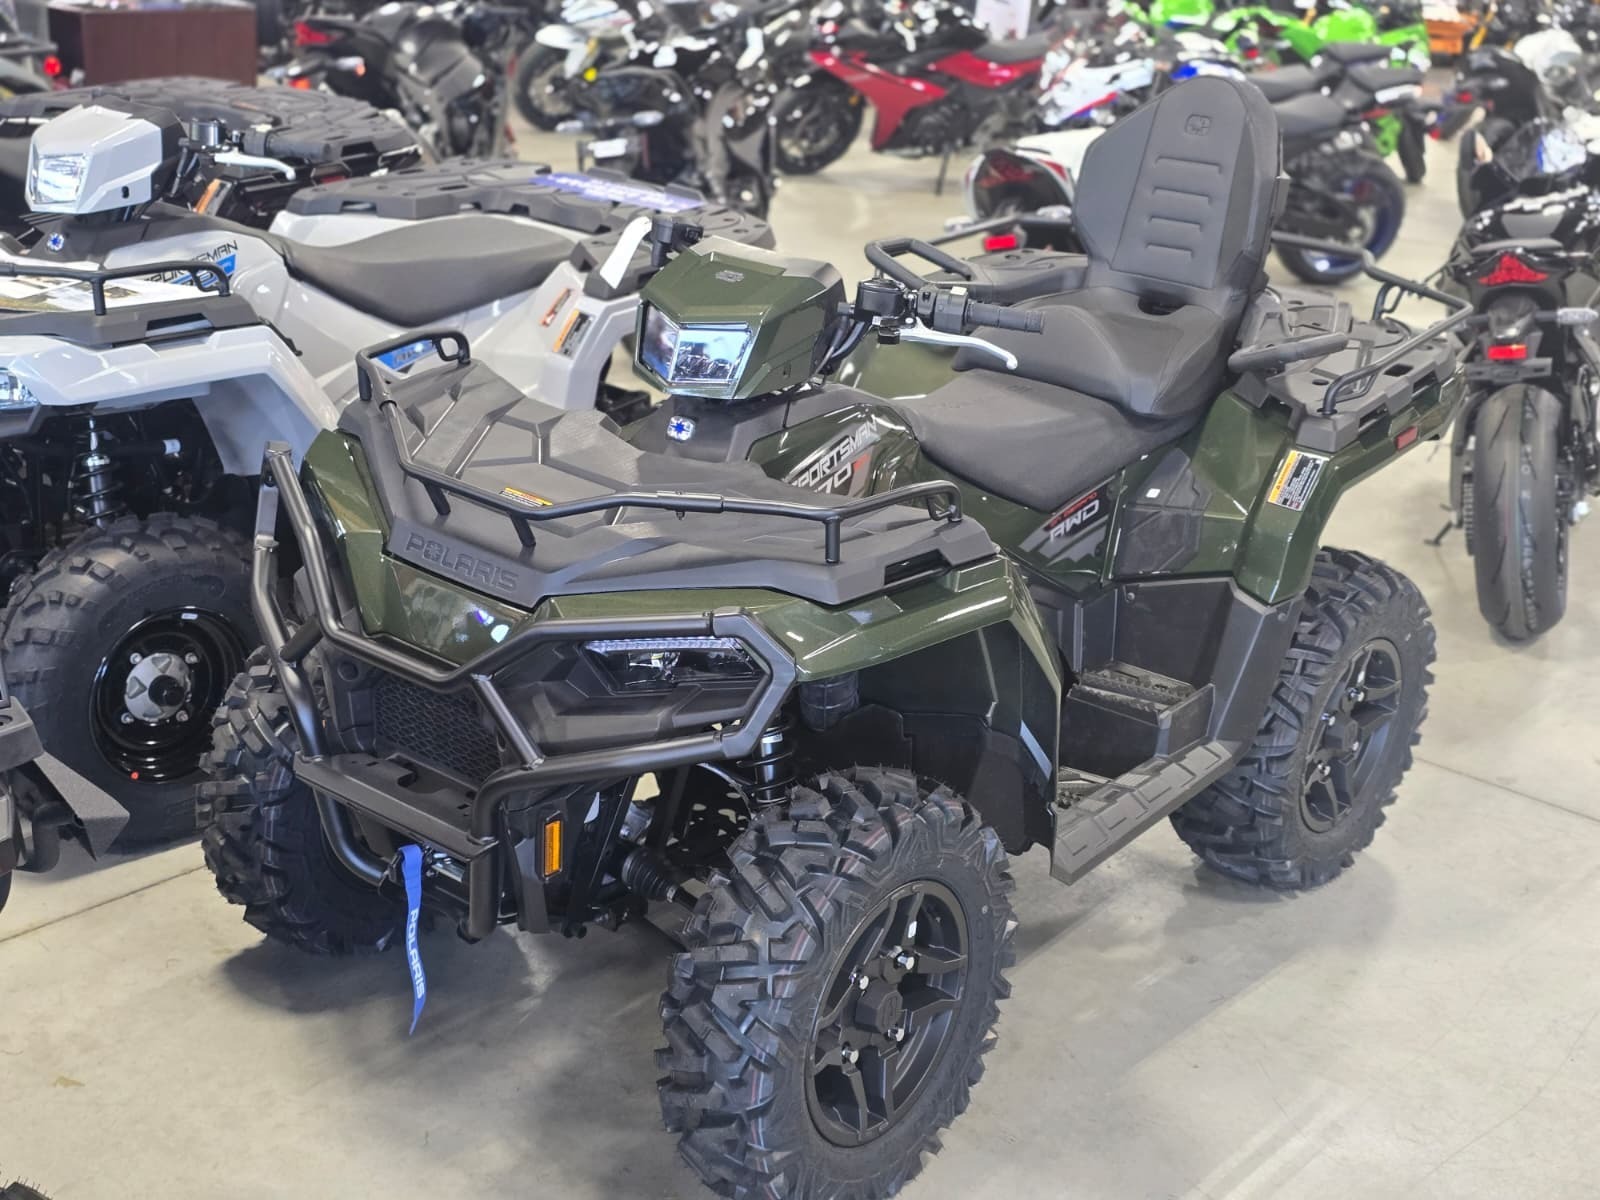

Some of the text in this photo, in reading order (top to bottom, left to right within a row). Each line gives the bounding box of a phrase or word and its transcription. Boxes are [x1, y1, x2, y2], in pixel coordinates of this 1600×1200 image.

[791, 415, 879, 488] PORTSMAN
[813, 462, 853, 494] 70
[1050, 499, 1099, 543] AWD
[404, 531, 520, 594] POLARIS
[408, 907, 425, 999] POLARIS
